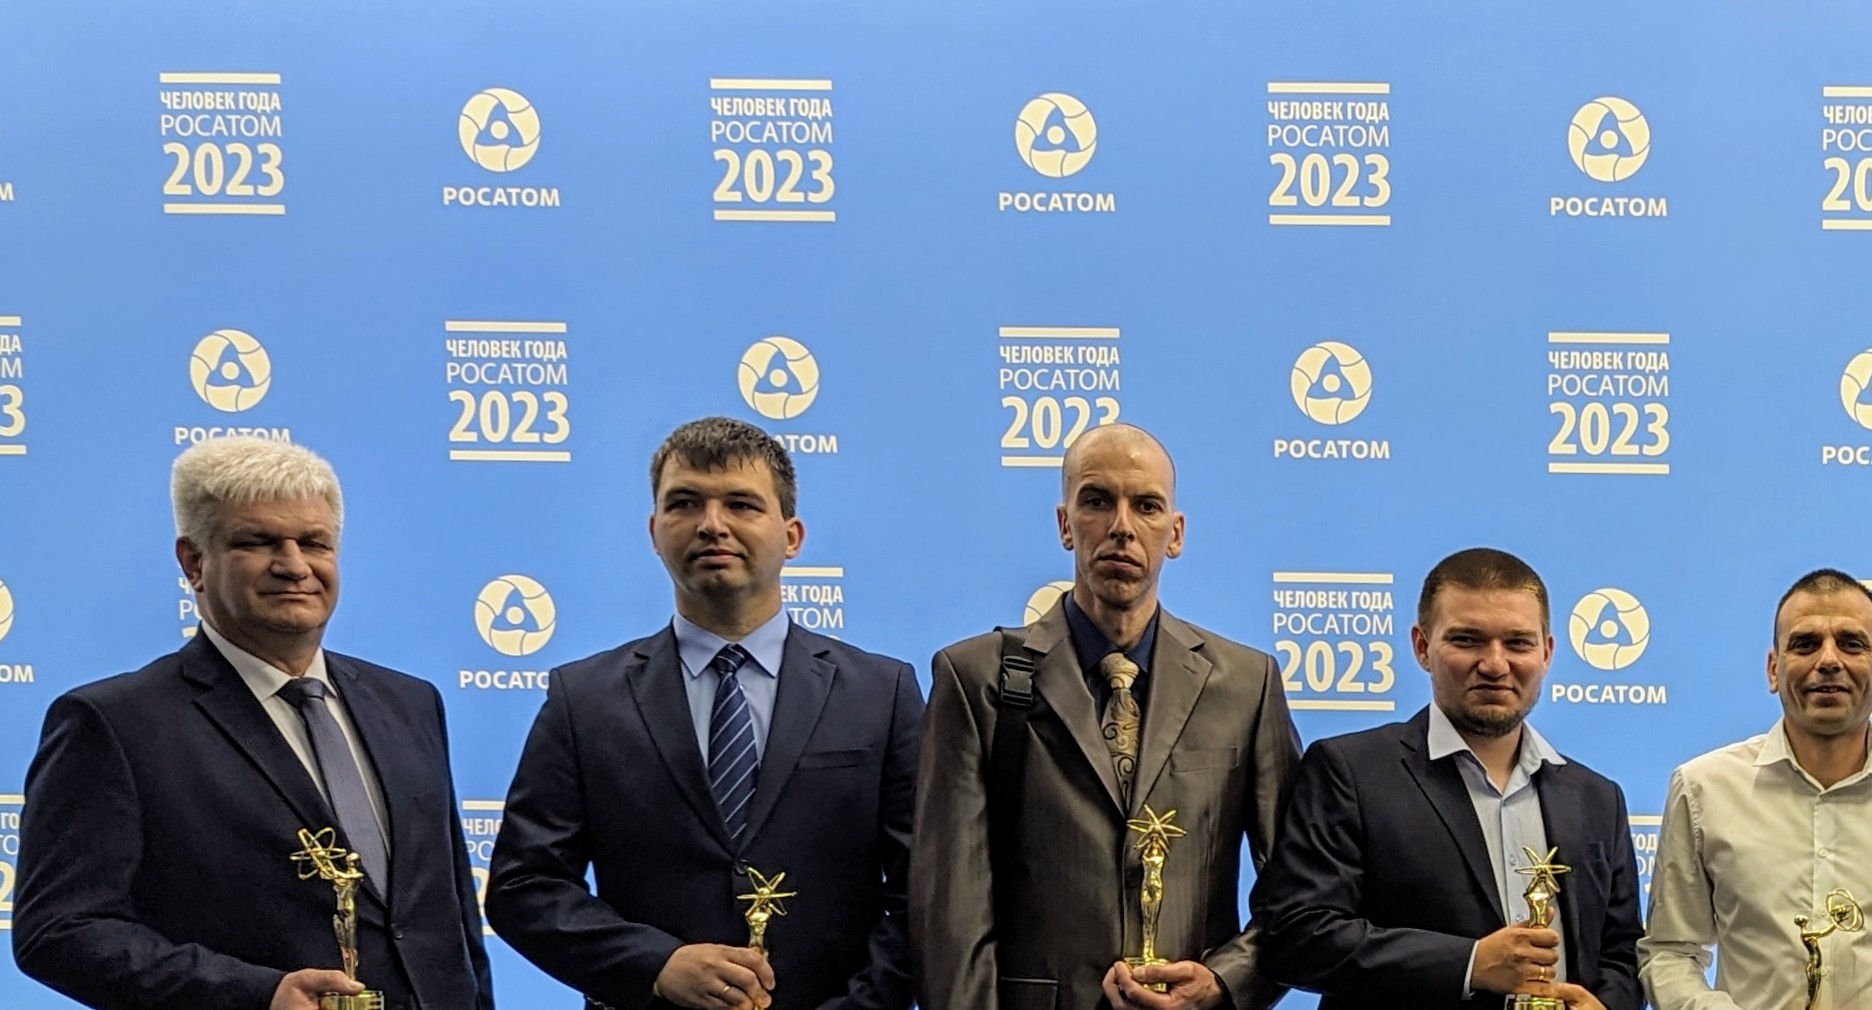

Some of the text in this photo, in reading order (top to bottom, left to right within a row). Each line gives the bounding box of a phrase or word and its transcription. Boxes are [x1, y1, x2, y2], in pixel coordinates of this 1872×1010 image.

[161, 92, 280, 112] ЧЕЛОВЕК ГОДА
[711, 98, 832, 118] ЧЕЛОВЕК ГОДА
[1269, 103, 1388, 122] ЧЕЛОВЕК ГОДА
[160, 114, 281, 136] РОСАТОМ
[711, 120, 833, 143] РОСАТОМ
[1267, 125, 1389, 147] РОСАТОМ
[164, 142, 284, 196] 2023
[714, 149, 834, 202] 2023
[1270, 153, 1391, 207] 2023
[443, 187, 560, 205] РОСАТОМ
[998, 193, 1114, 211] РОСАТОМ
[1551, 198, 1667, 216] РОСАТОМ
[0, 335, 22, 356] ДА
[447, 341, 566, 360] ЧЕЛОВЕК ГОДА
[1000, 346, 1119, 365] ЧЕЛОВЕК ГОДА
[446, 359, 567, 384] РОСАТОМ
[1550, 352, 1668, 371] ЧЕЛОВЕК ГОДА
[999, 365, 1120, 390] РОСАТОМ
[1548, 374, 1668, 397] РОСАТОМ
[449, 390, 570, 443] 2023
[1549, 402, 1669, 456] 2023
[1274, 440, 1390, 458] РОСАТОМ
[801, 586, 842, 604] ГОДА
[1274, 591, 1392, 611] ЧЕЛОВЕК ГОДА
[1273, 610, 1392, 634] РОСАТОМ
[1284, 643, 1395, 693] 2023
[460, 671, 549, 690] РОСАТО
[1552, 684, 1667, 703] РОСАТОМ
